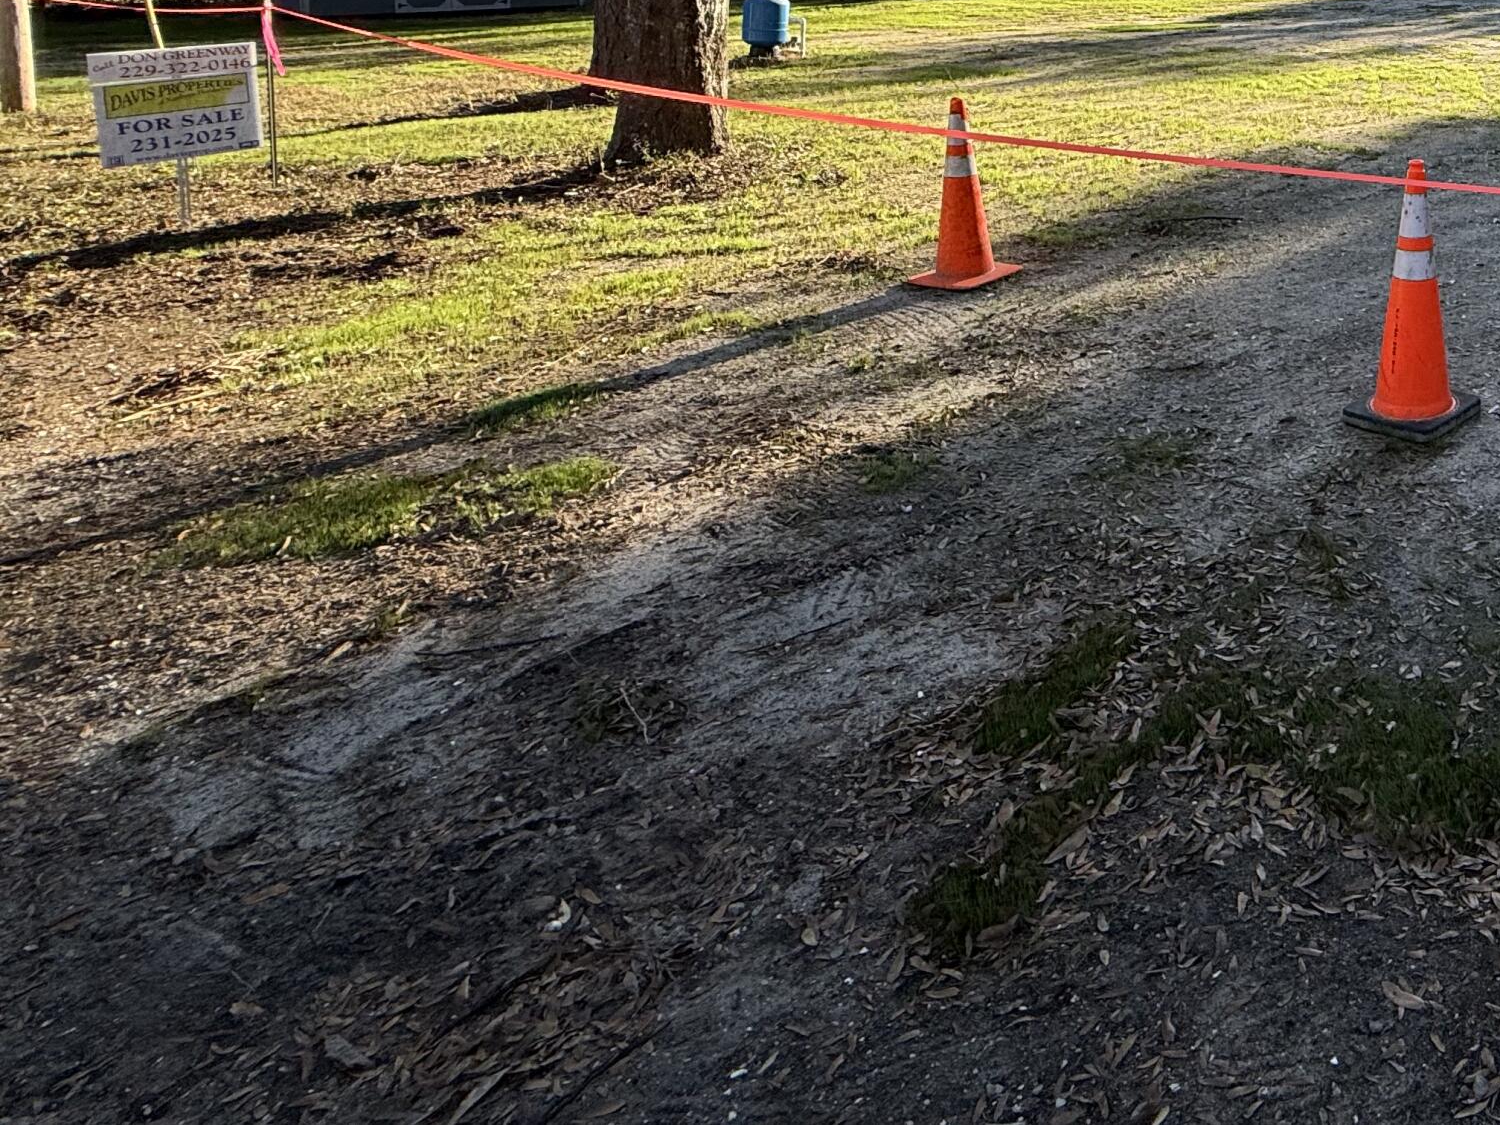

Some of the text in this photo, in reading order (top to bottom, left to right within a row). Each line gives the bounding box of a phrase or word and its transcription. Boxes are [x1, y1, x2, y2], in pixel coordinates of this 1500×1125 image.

[118, 51, 157, 65] DON
[162, 44, 250, 61] GREENWAY
[119, 57, 251, 79] 229-322-0146
[110, 88, 155, 112] DAVIS
[158, 78, 244, 98] PROPERTIES
[116, 108, 244, 136] FOR SALE
[131, 127, 237, 153] 231-2025
